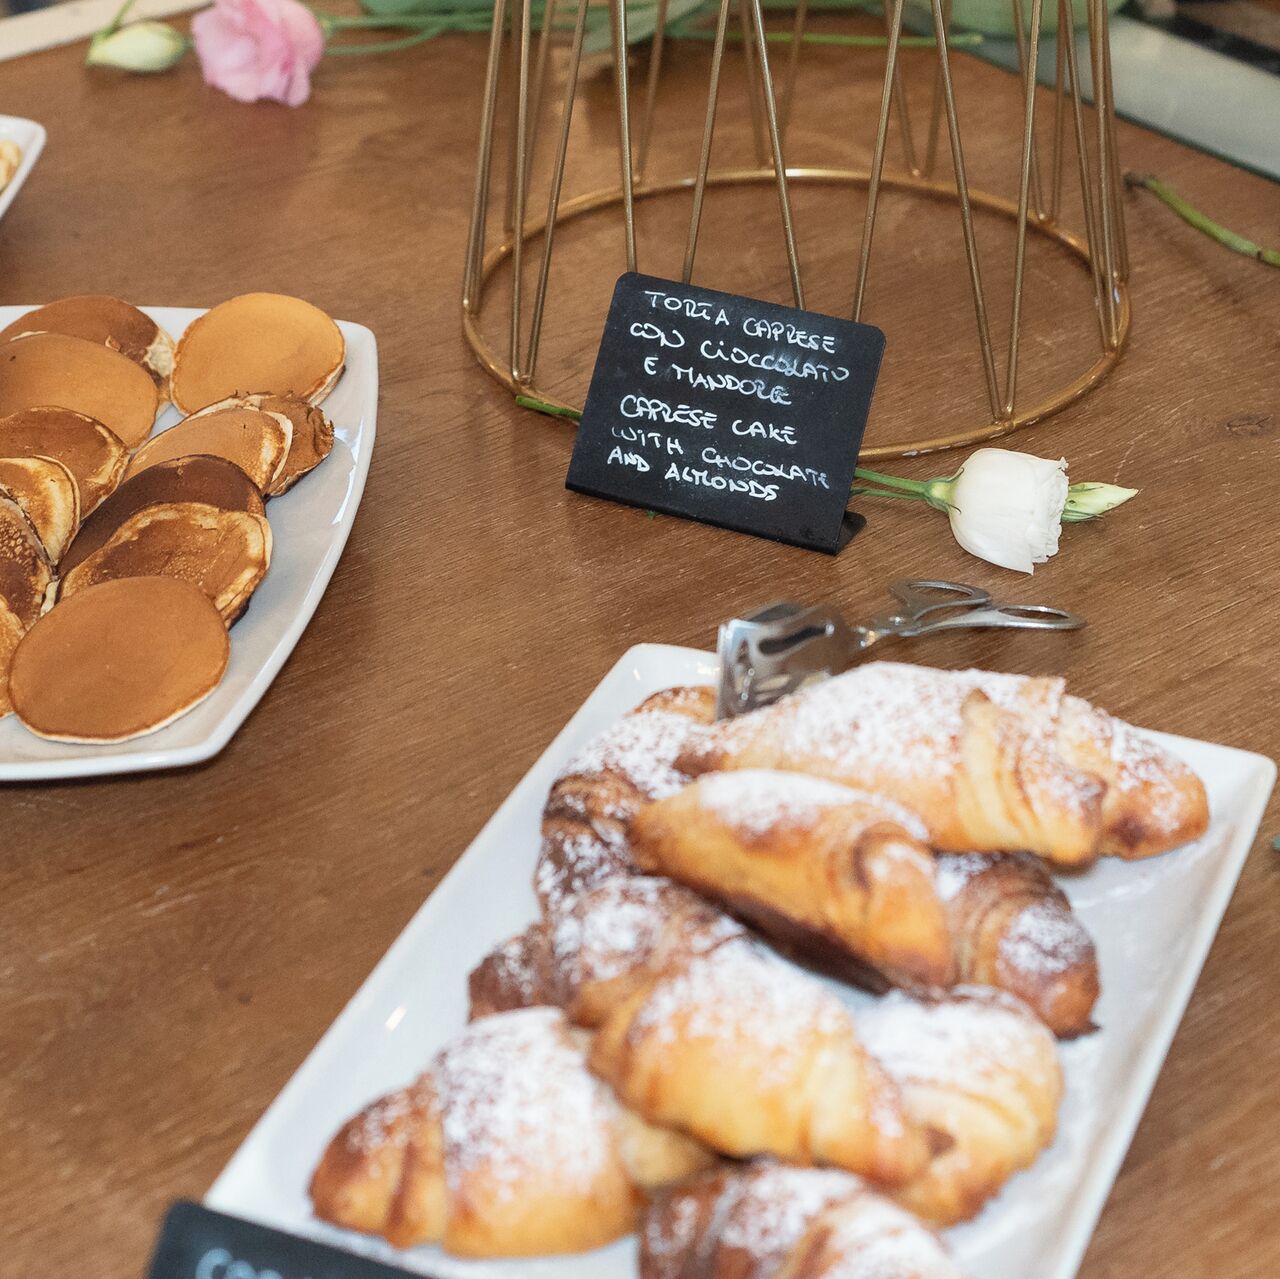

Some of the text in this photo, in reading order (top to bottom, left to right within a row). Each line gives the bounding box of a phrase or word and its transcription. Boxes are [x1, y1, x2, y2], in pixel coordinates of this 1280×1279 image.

[644, 290, 730, 326] TORTA
[630, 322, 686, 349] CON
[644, 356, 659, 376] E
[731, 419, 798, 445] CAKE
[606, 446, 651, 473] AND
[701, 447, 831, 490] CHOCOLATE
